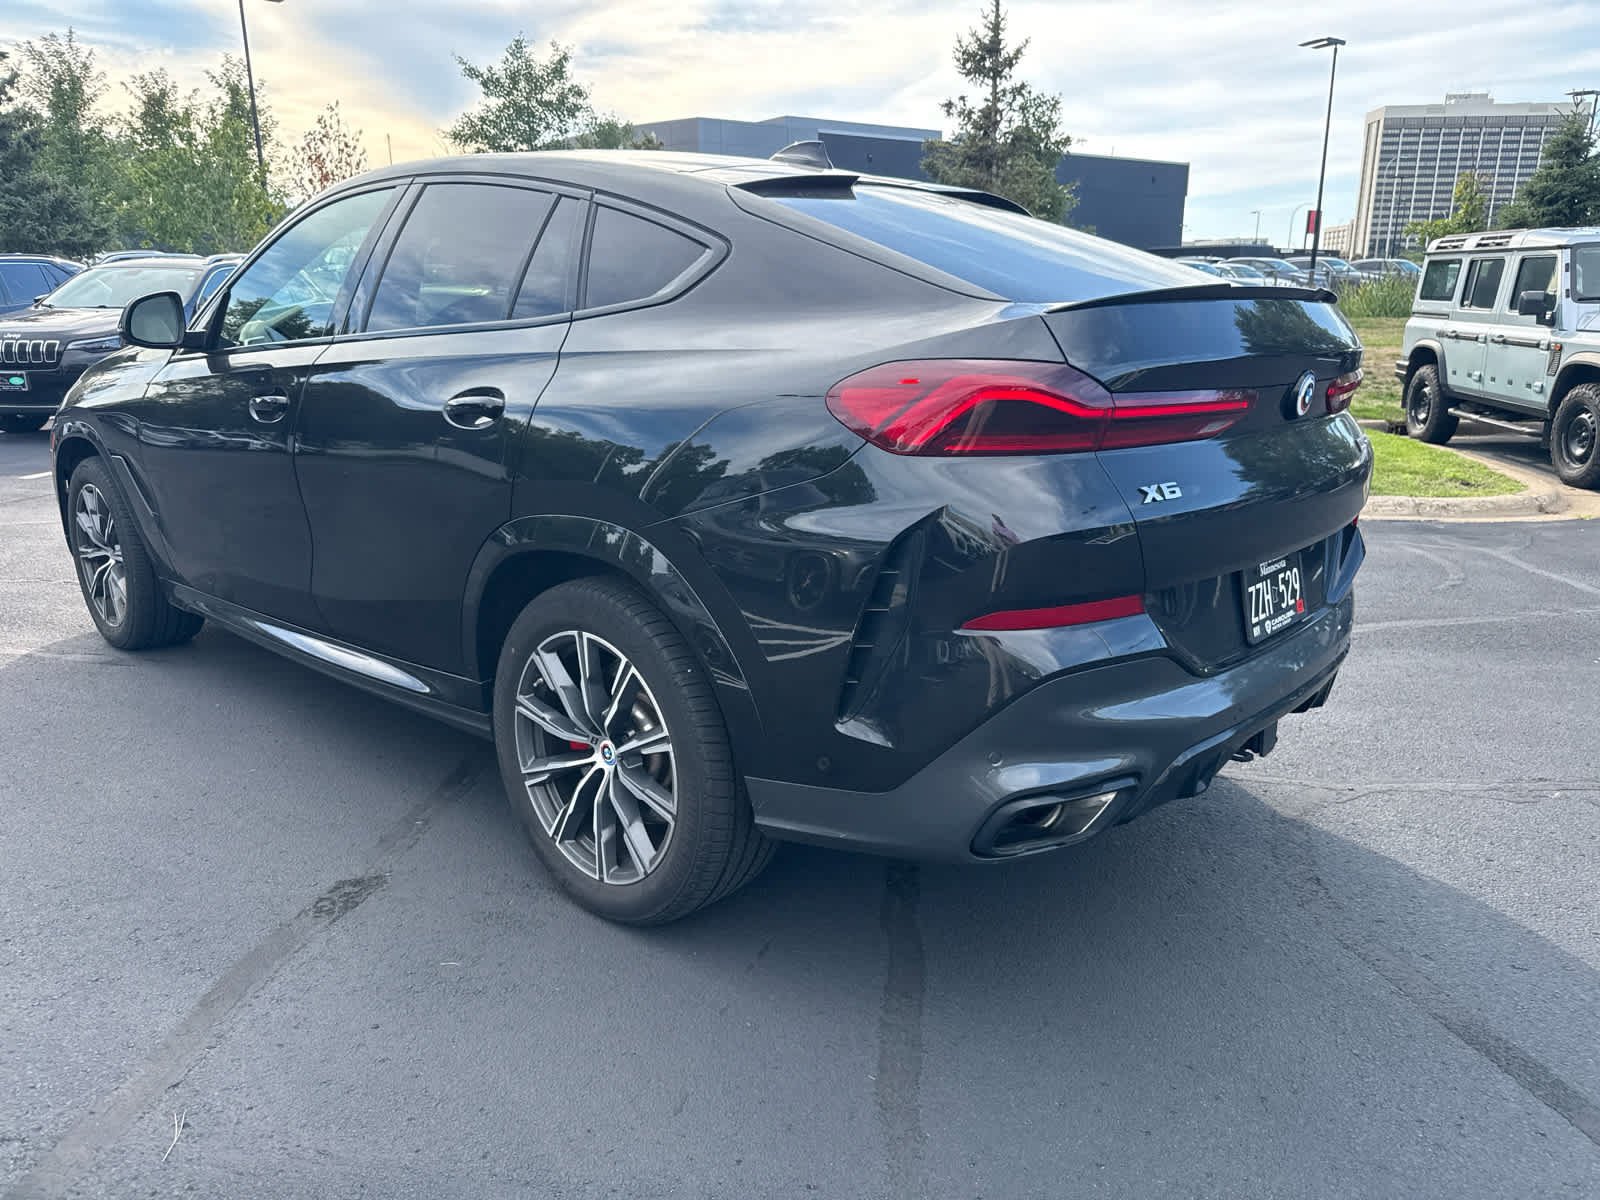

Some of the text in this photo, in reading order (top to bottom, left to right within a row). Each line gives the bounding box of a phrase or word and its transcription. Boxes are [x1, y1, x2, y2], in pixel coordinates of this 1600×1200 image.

[1138, 481, 1183, 504] X6
[1247, 567, 1301, 624] ZZH 529
